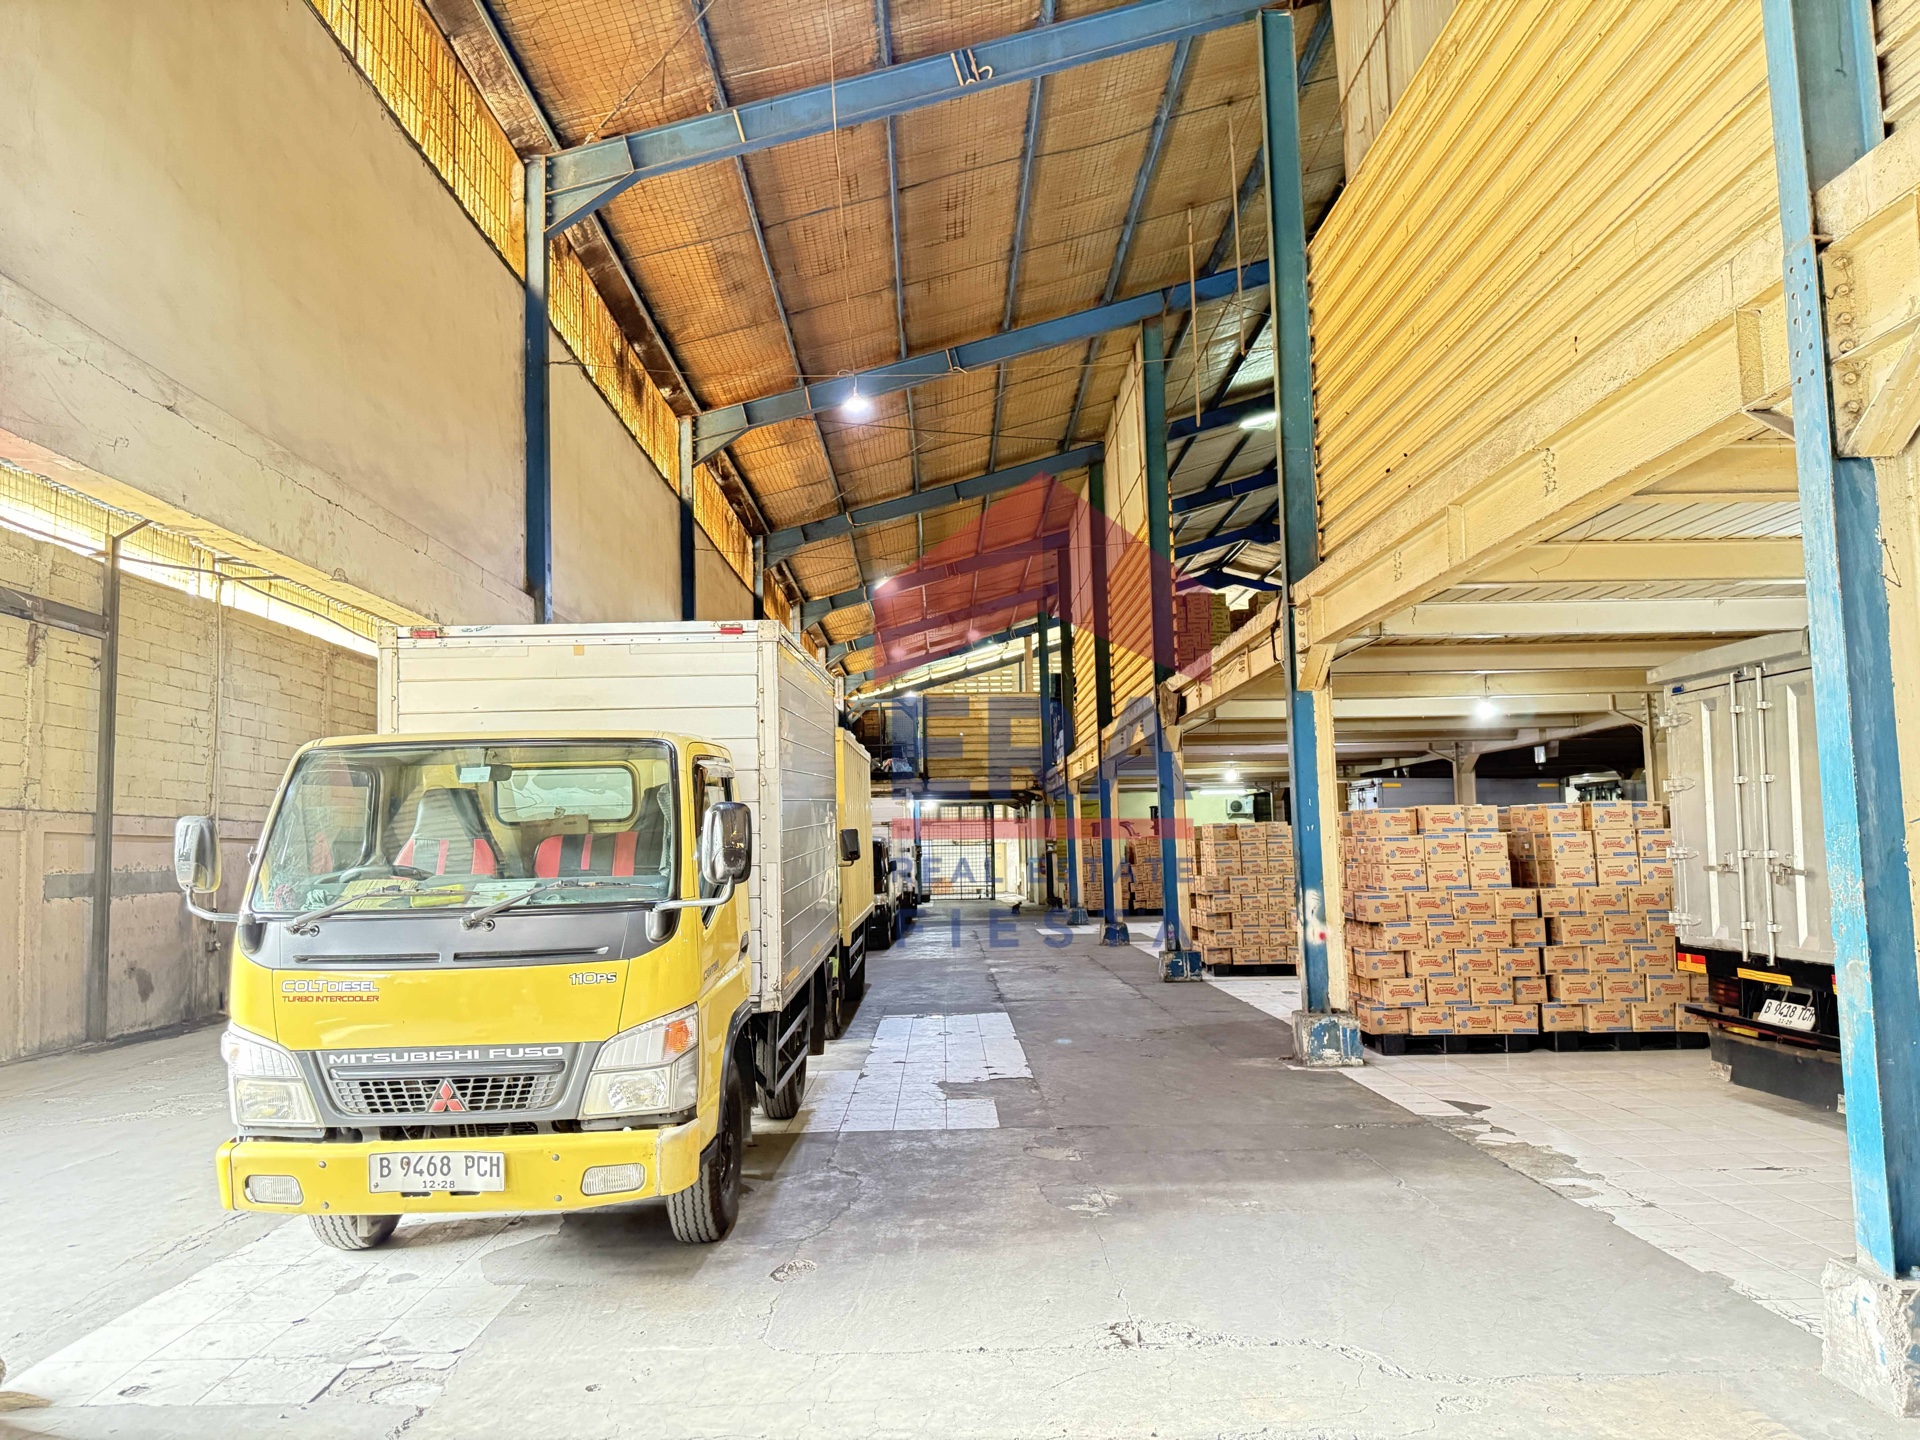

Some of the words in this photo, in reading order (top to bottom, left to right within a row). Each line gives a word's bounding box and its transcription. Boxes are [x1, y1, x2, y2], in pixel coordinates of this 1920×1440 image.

[569, 972, 617, 985] 110PS
[1764, 1001, 1773, 1014] B
[329, 1049, 479, 1064] MITSUBISHI
[489, 1046, 564, 1059] FUSO
[379, 1157, 392, 1178] B
[400, 1155, 452, 1177] 9468
[464, 1155, 500, 1178] PCH
